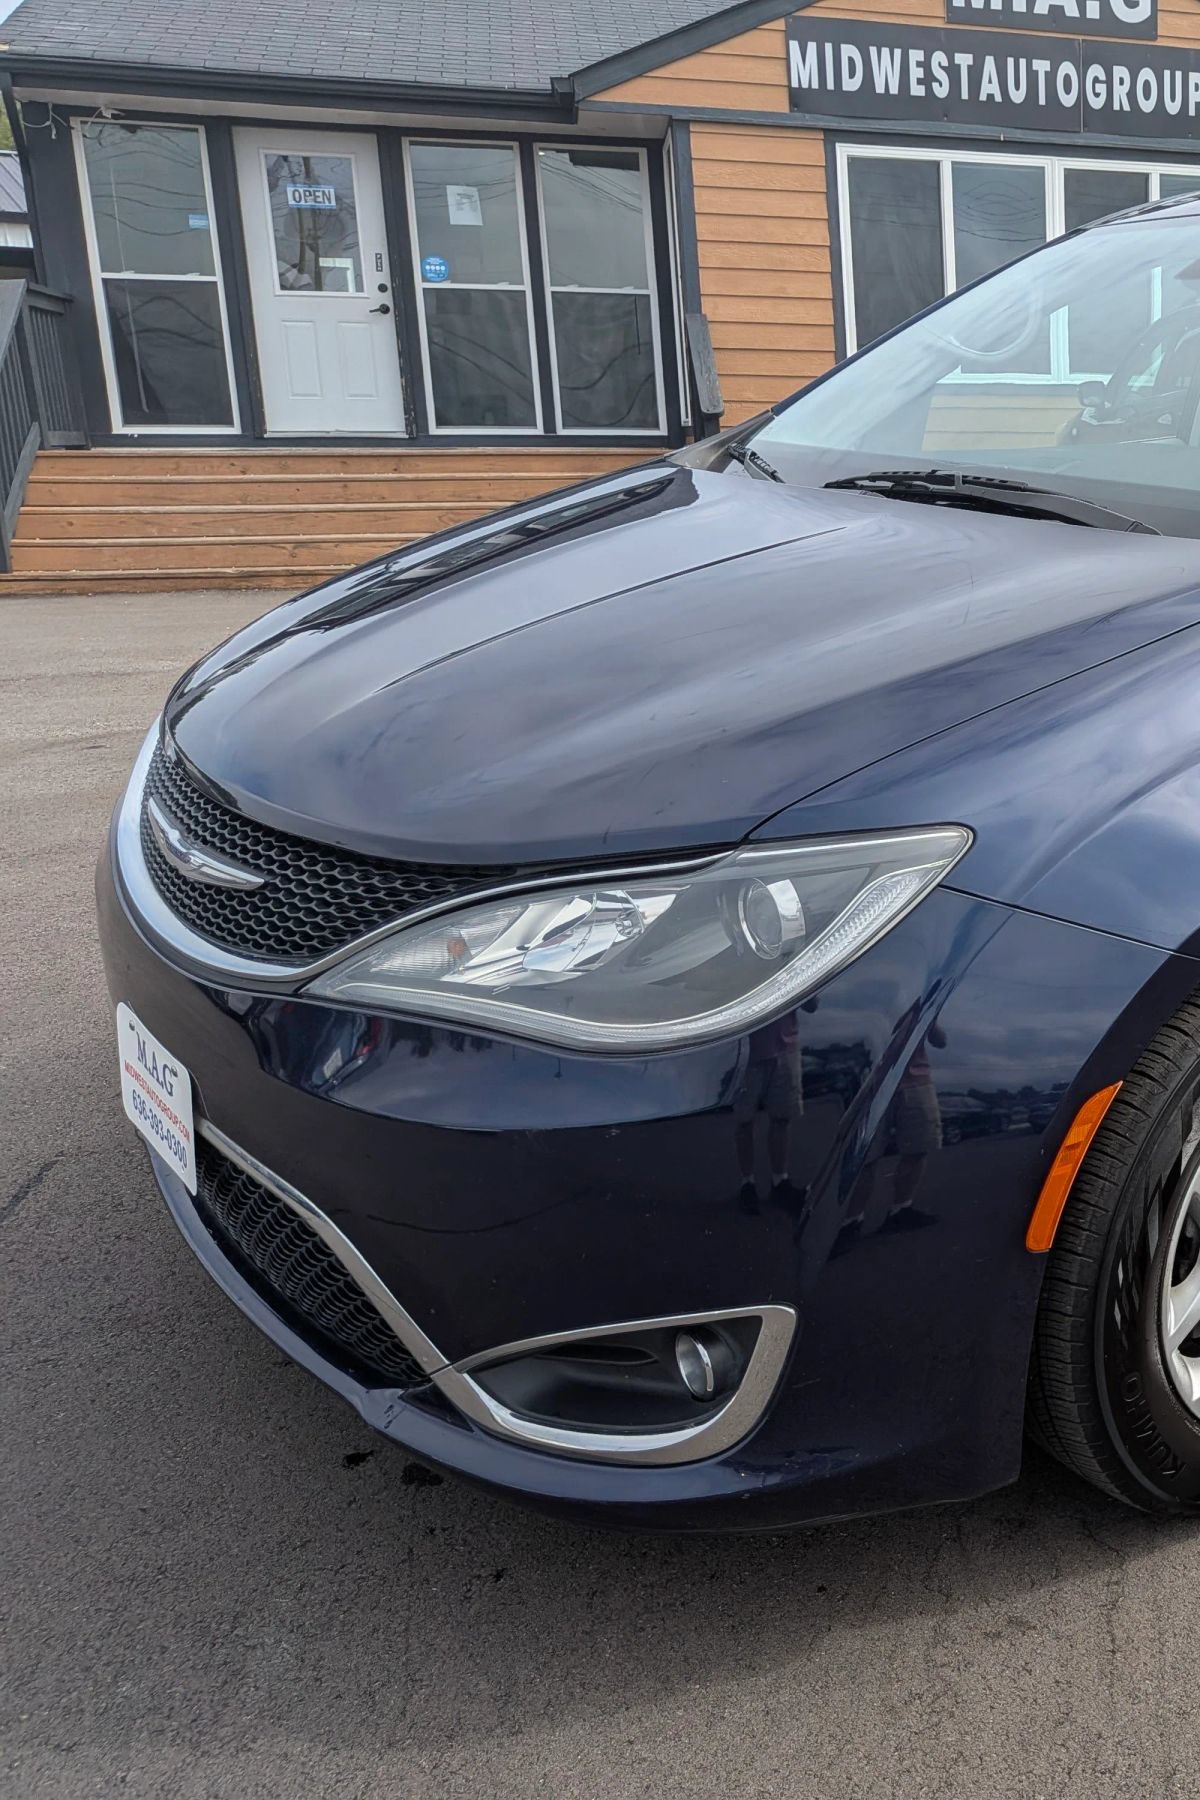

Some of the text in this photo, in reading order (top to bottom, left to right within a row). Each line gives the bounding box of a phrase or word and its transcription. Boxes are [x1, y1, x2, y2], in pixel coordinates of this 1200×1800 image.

[292, 188, 333, 205] OPEN
[124, 1059, 191, 1144] MIDWESTAUTOGROUP.COM
[132, 1088, 188, 1170] 636-393-0300
